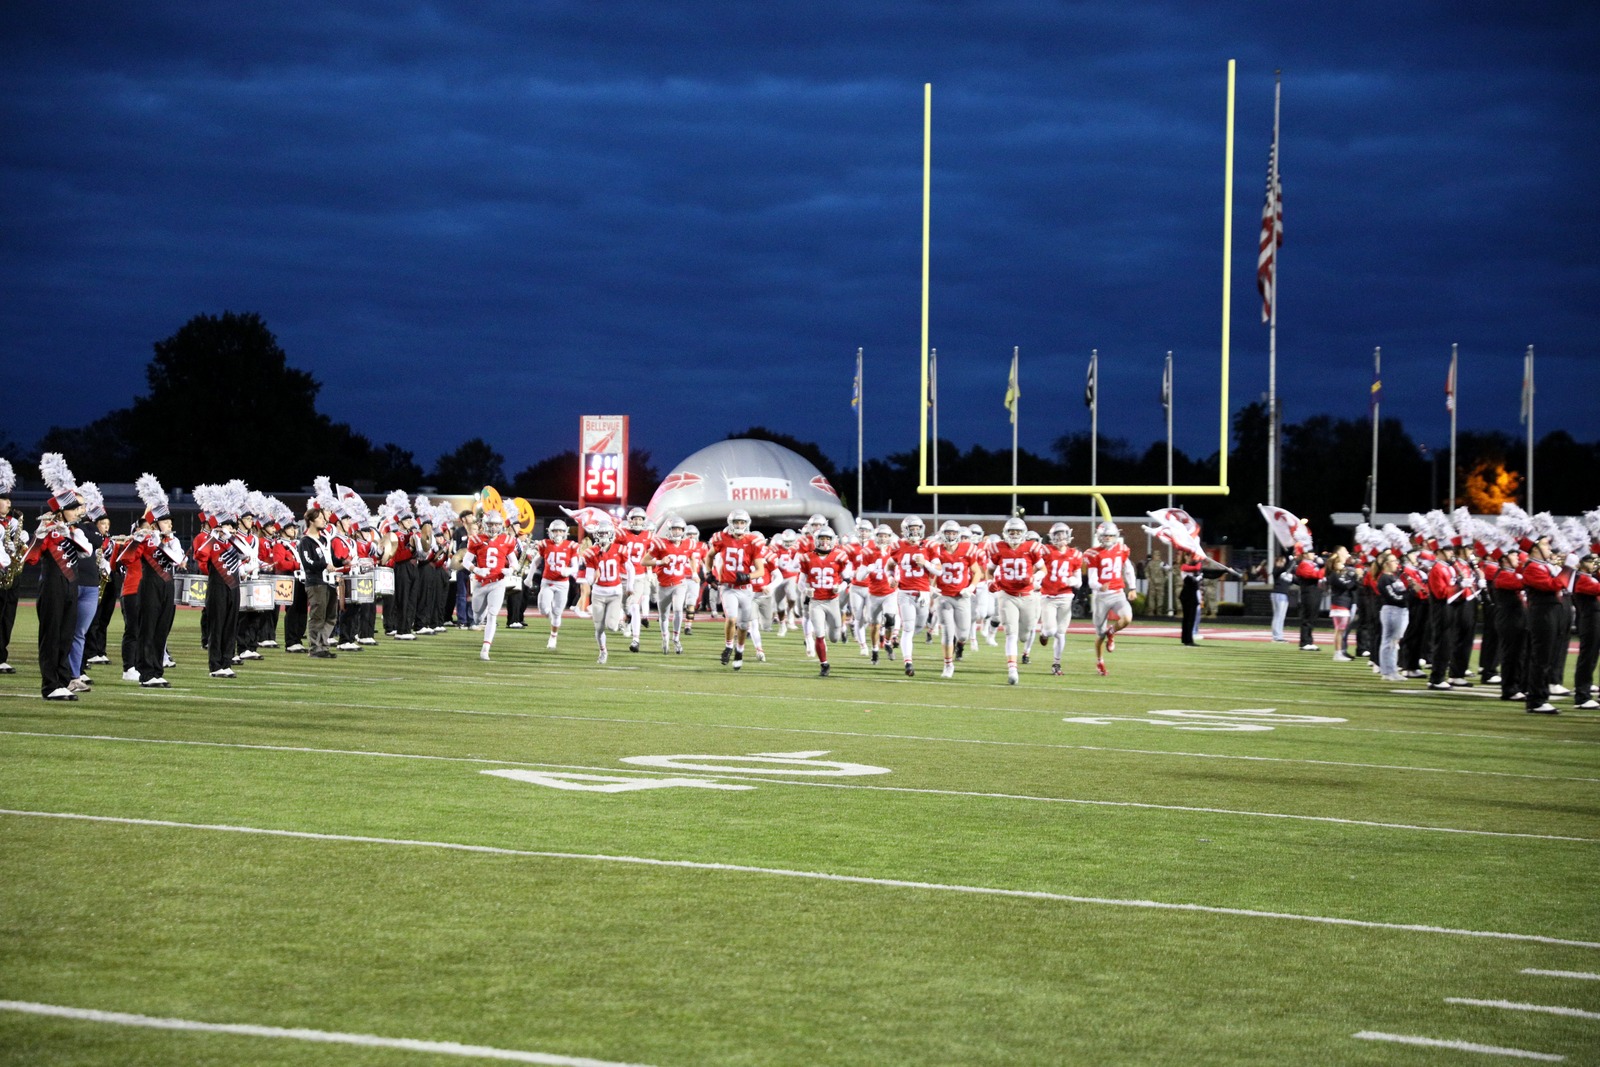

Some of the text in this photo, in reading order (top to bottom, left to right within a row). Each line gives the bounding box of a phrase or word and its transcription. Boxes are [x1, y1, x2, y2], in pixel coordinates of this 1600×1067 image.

[586, 420, 620, 431] BELLEVUE
[586, 469, 616, 495] 25
[732, 487, 788, 500] REDMEN
[486, 547, 498, 568] 6
[546, 551, 567, 572] 45
[627, 541, 644, 563] 13
[725, 546, 744, 571] 51
[598, 558, 618, 582] 10
[810, 567, 835, 589] 36
[942, 562, 965, 584] 63
[1002, 557, 1026, 581] 50
[1050, 559, 1070, 582] 14
[1101, 556, 1123, 580] 24
